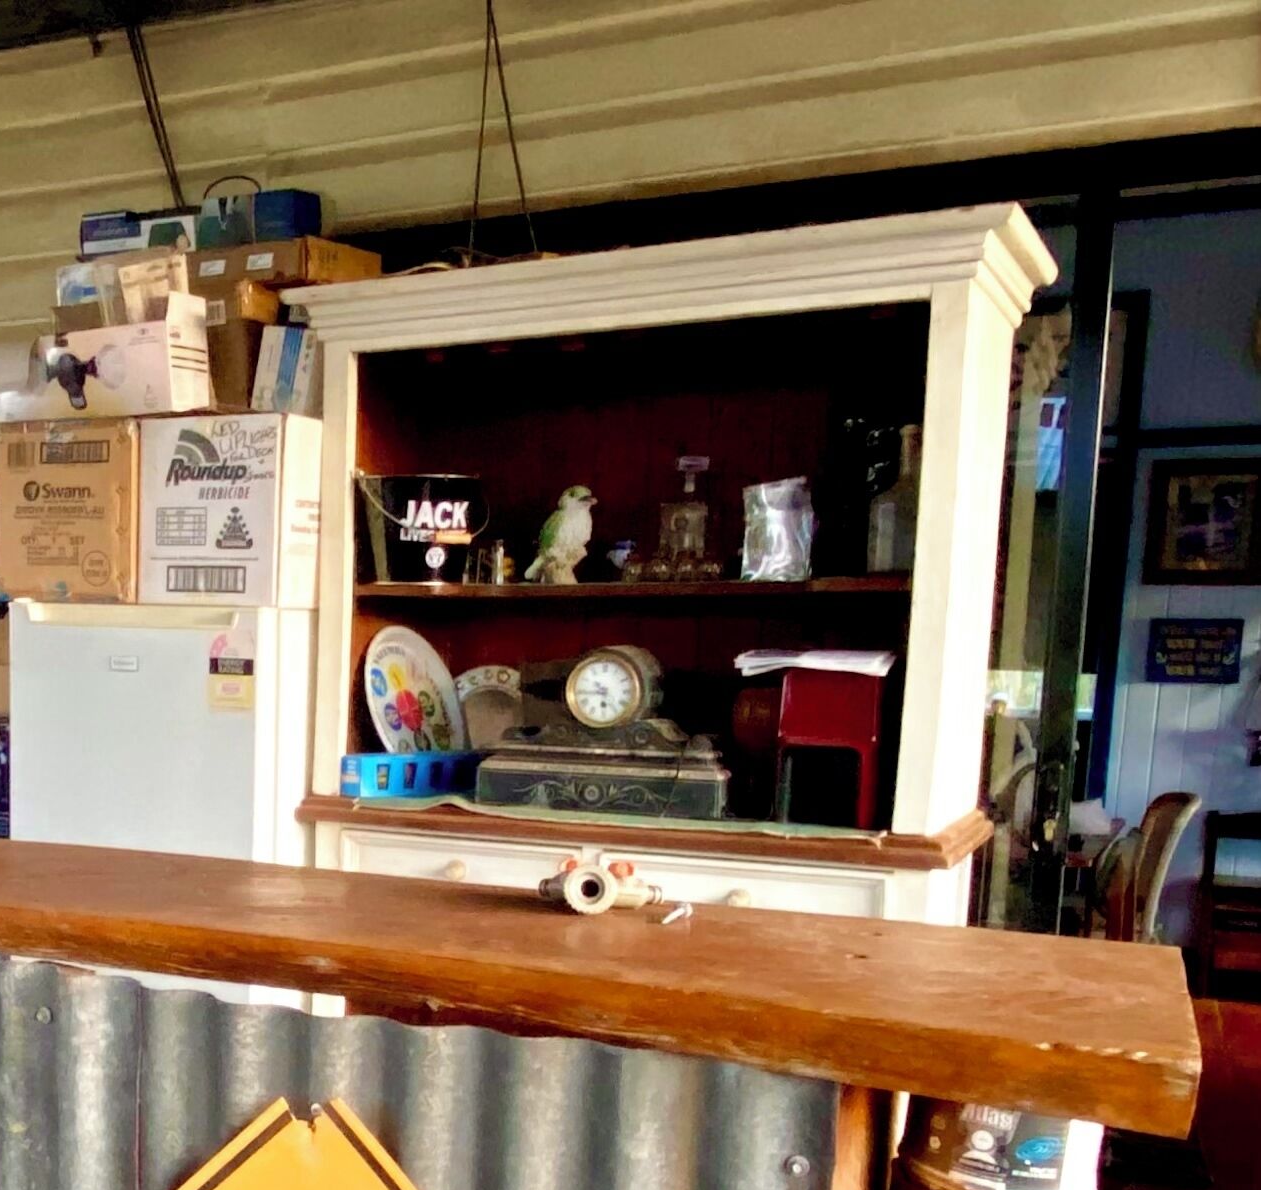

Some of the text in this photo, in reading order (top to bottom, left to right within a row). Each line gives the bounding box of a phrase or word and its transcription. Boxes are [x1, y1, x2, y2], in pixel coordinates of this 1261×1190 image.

[166, 458, 247, 487] Roundup
[42, 483, 92, 499] Swann
[198, 486, 250, 500] HERBICIDE
[399, 500, 469, 529] JACK
